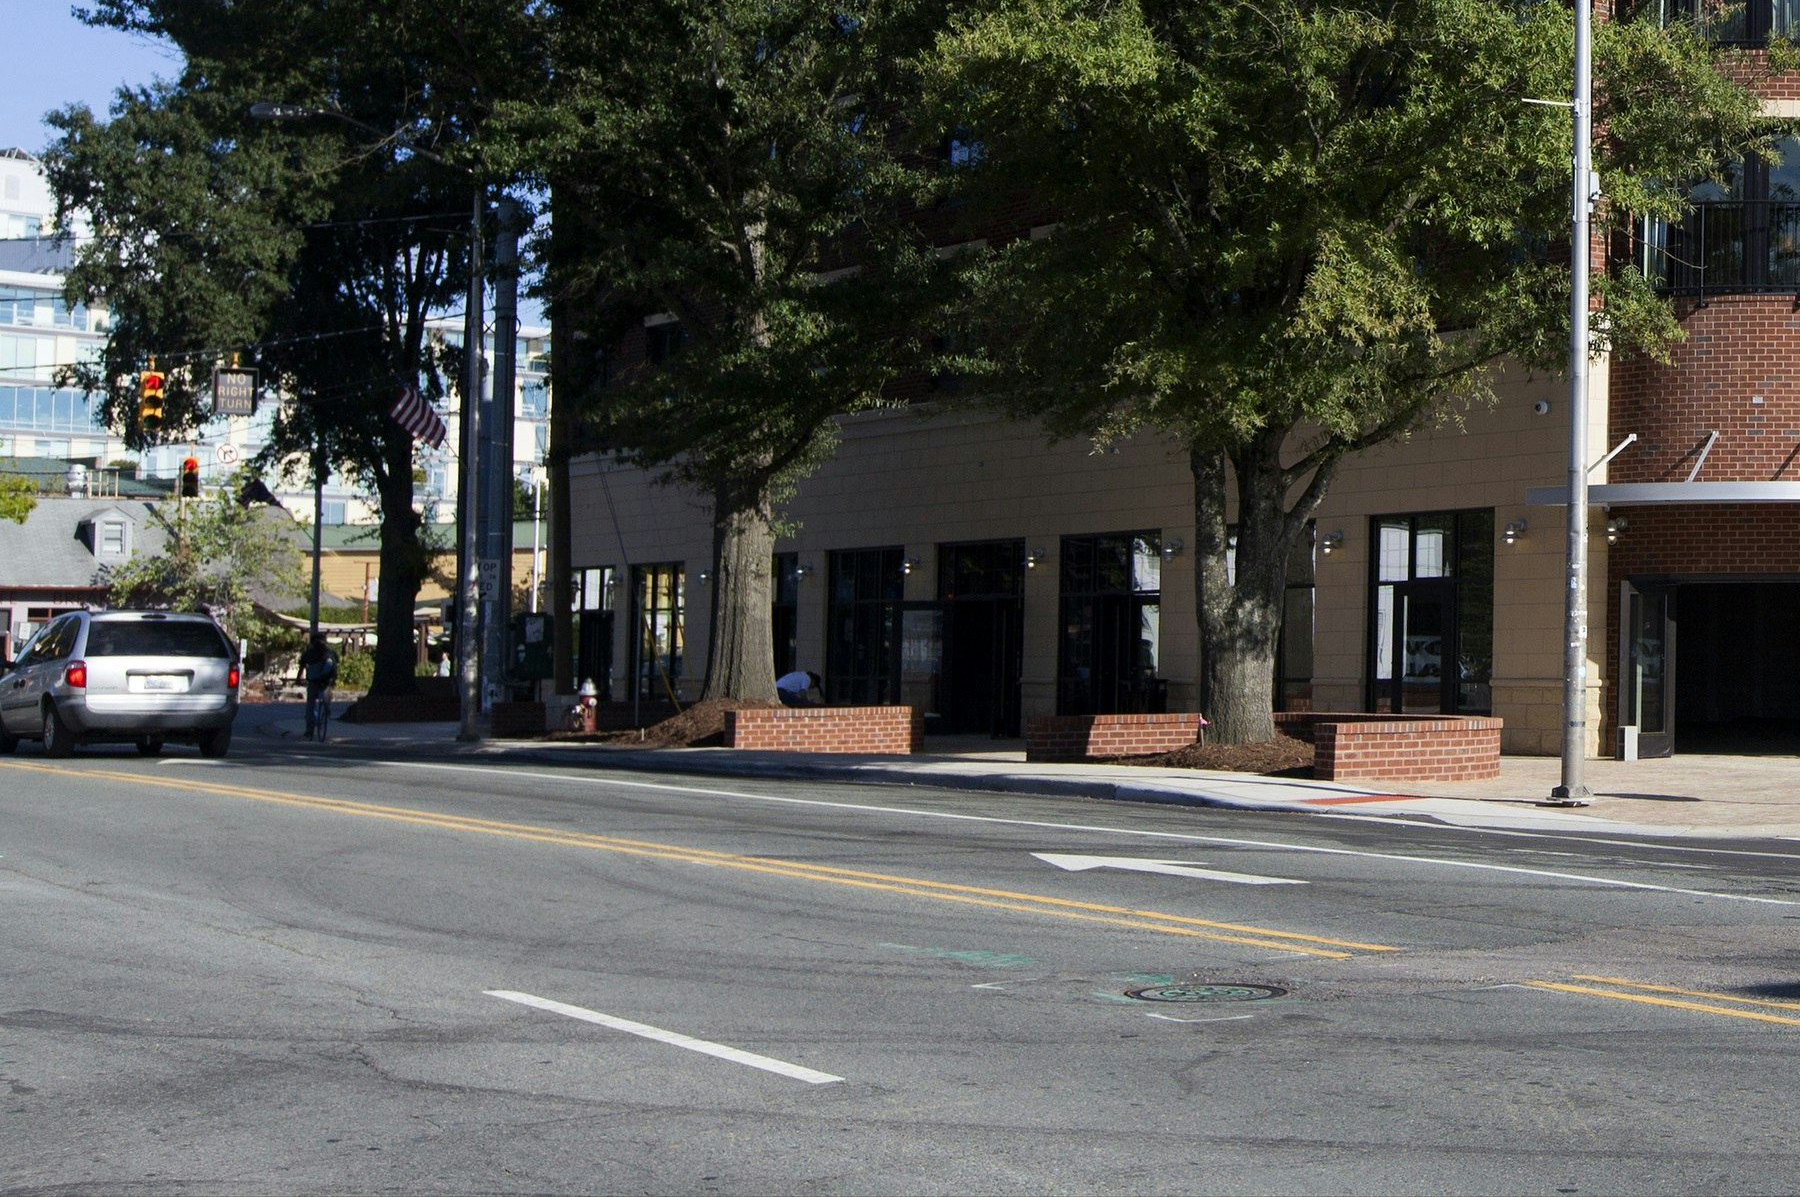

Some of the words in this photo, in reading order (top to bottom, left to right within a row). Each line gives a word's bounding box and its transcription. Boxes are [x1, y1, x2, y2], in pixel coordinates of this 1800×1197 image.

[227, 373, 246, 385] NO
[217, 385, 254, 397] RIGHT
[220, 398, 252, 409] TURN
